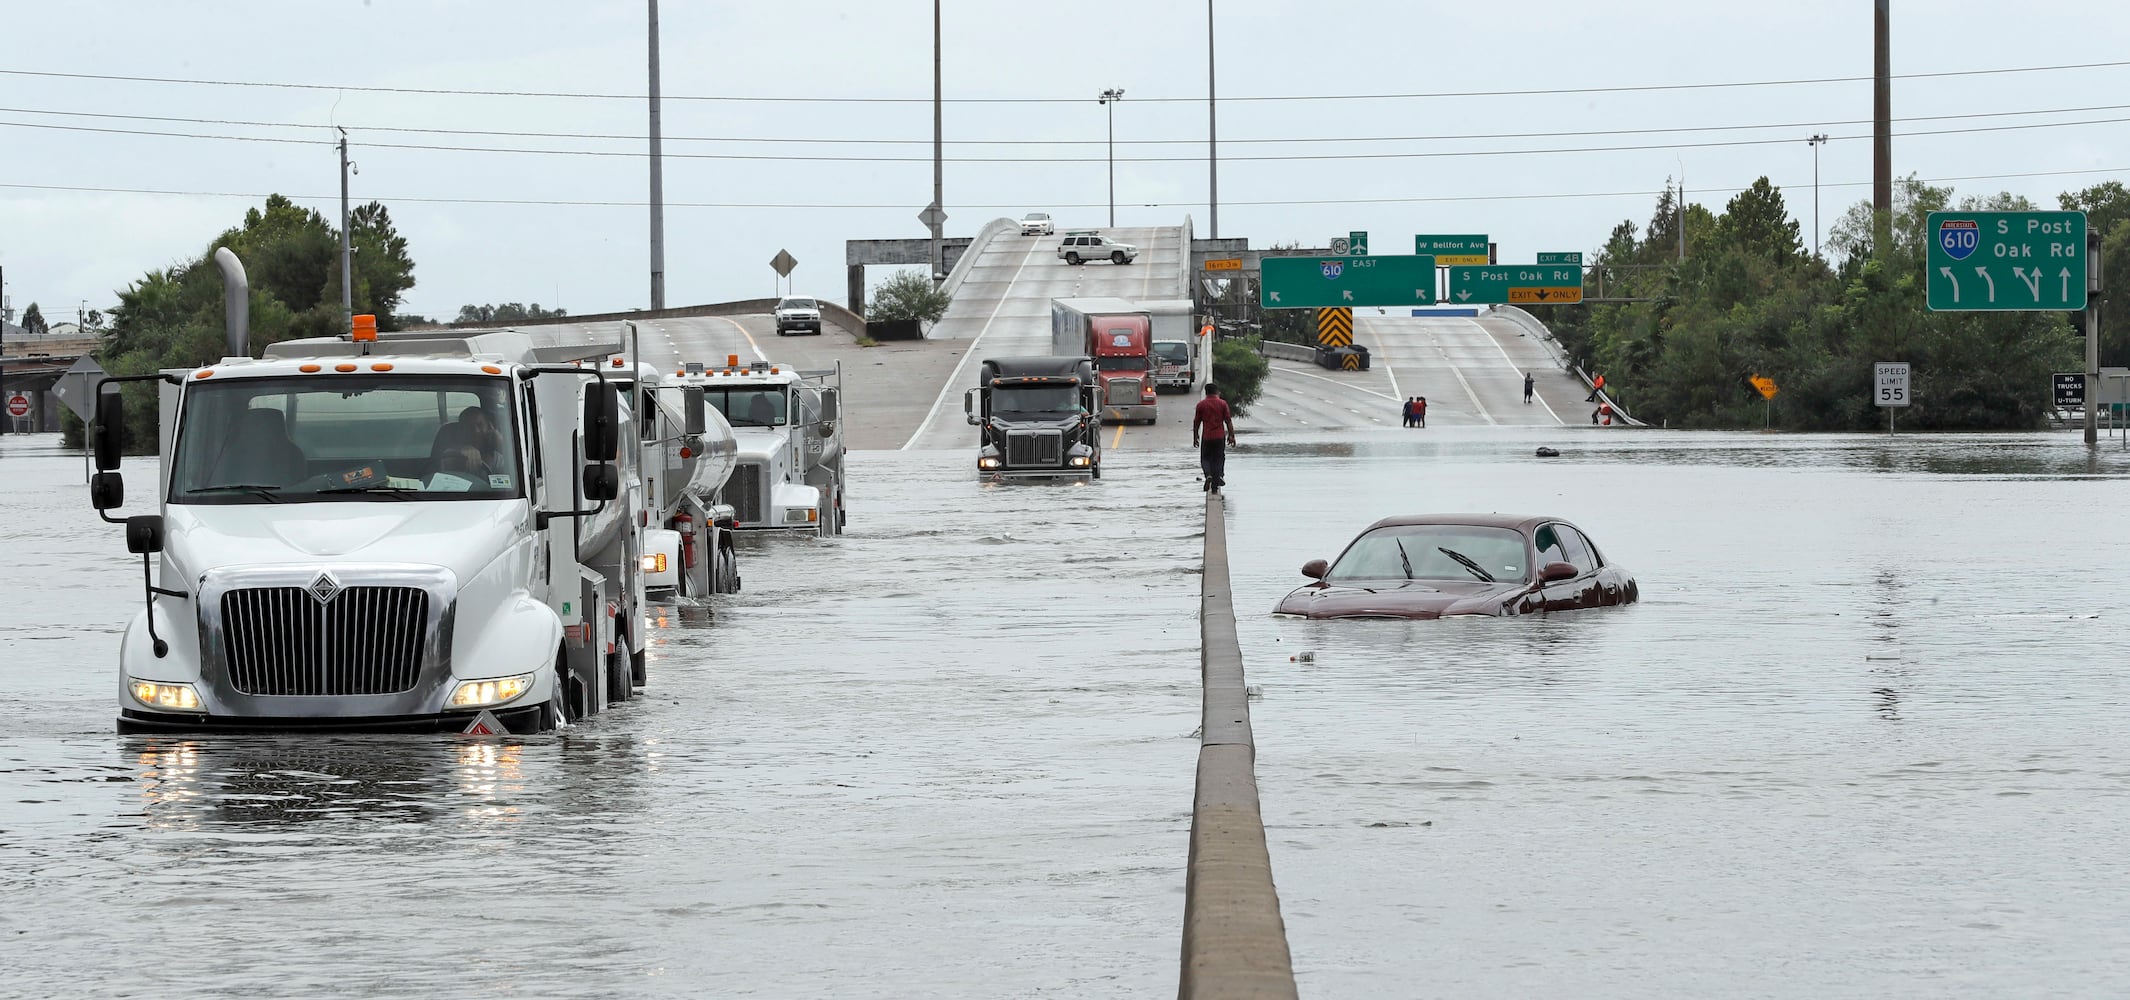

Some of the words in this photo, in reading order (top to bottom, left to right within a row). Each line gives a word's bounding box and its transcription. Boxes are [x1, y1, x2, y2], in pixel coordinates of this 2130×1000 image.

[1997, 219, 2009, 234] S
[2027, 219, 2072, 234] Post
[1944, 231, 1975, 249] 610
[1994, 243, 2032, 258] Oak
[2051, 243, 2075, 258] Rd
[1352, 259, 1377, 268] EAST
[1564, 254, 1579, 263] 4B
[1323, 265, 1342, 276] 610
[1463, 271, 1471, 281] S
[1481, 271, 1509, 281] Post
[1519, 271, 1543, 281] Oak
[1554, 271, 1569, 281] Rd
[1511, 291, 1532, 299] EXIT
[1552, 291, 1578, 299] ONLY
[1878, 367, 1907, 375] SPEED
[1881, 388, 1904, 401] 55
